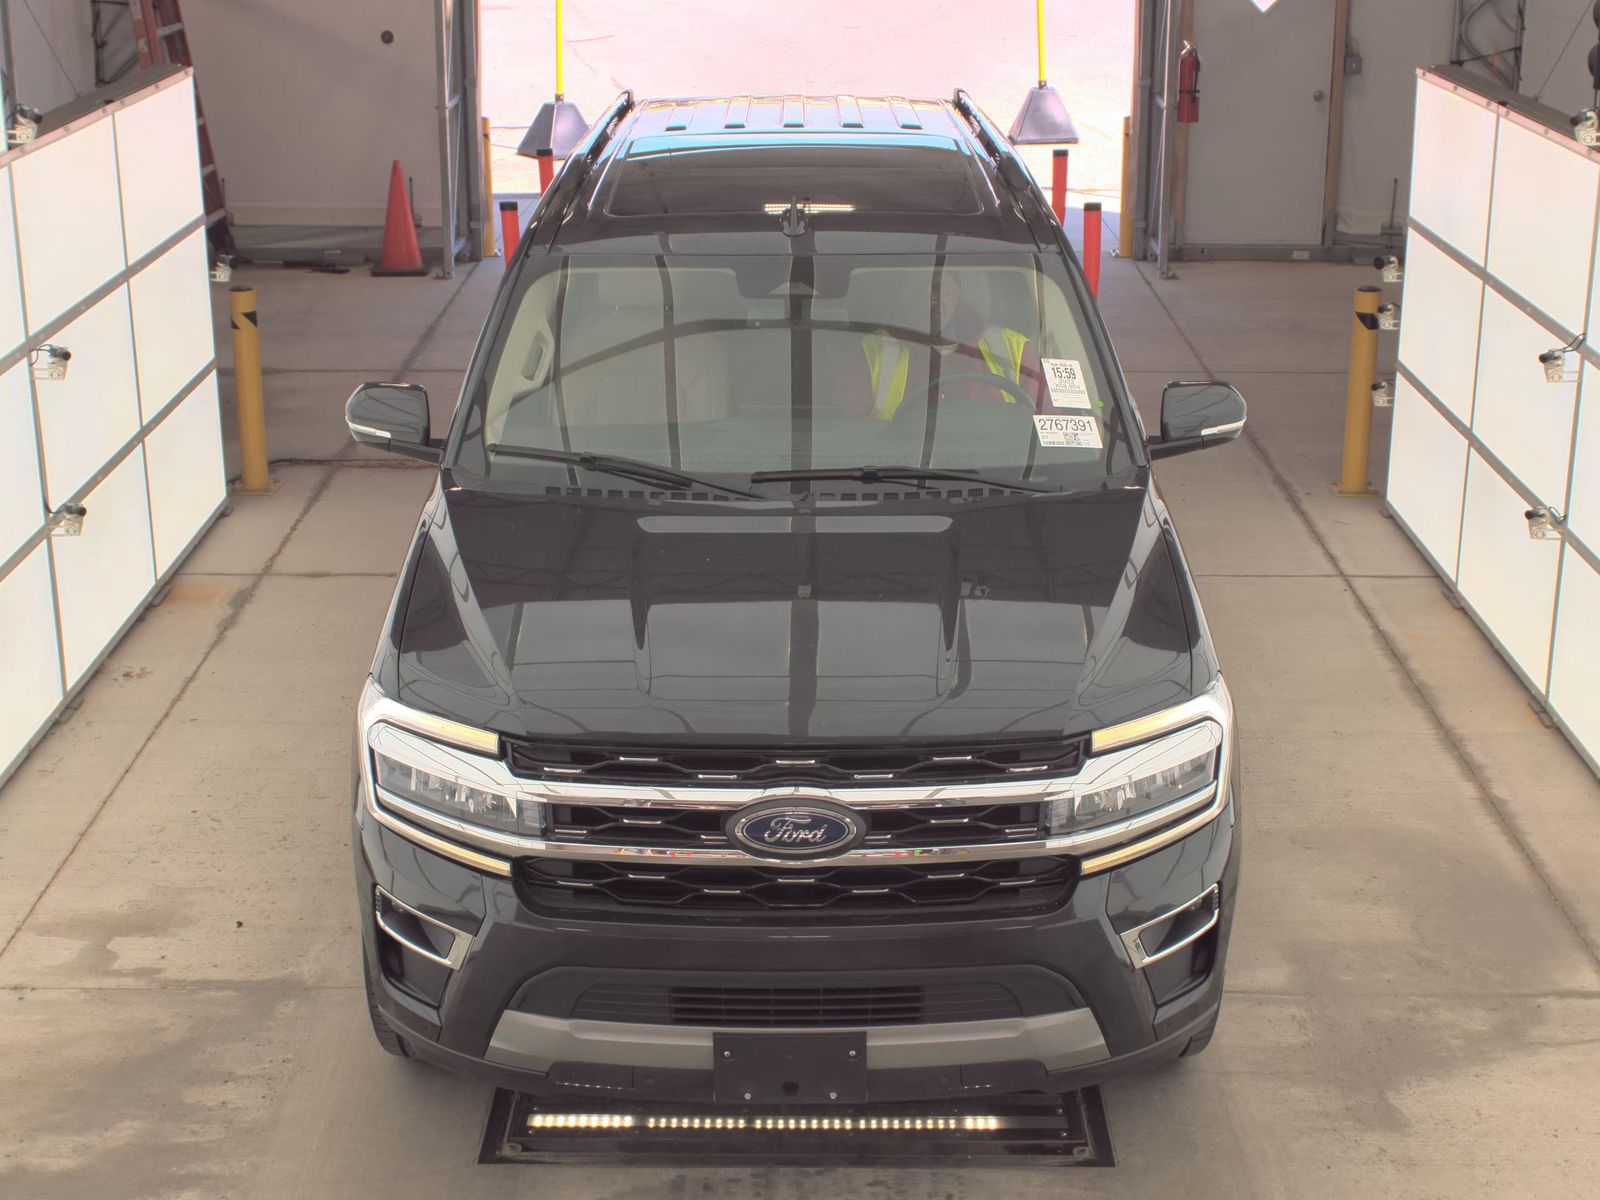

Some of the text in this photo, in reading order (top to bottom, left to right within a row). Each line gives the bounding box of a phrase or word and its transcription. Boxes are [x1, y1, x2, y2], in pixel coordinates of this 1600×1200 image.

[1052, 367, 1076, 380] 15:59
[1039, 418, 1093, 432] 2767391
[764, 816, 827, 843] Ford
